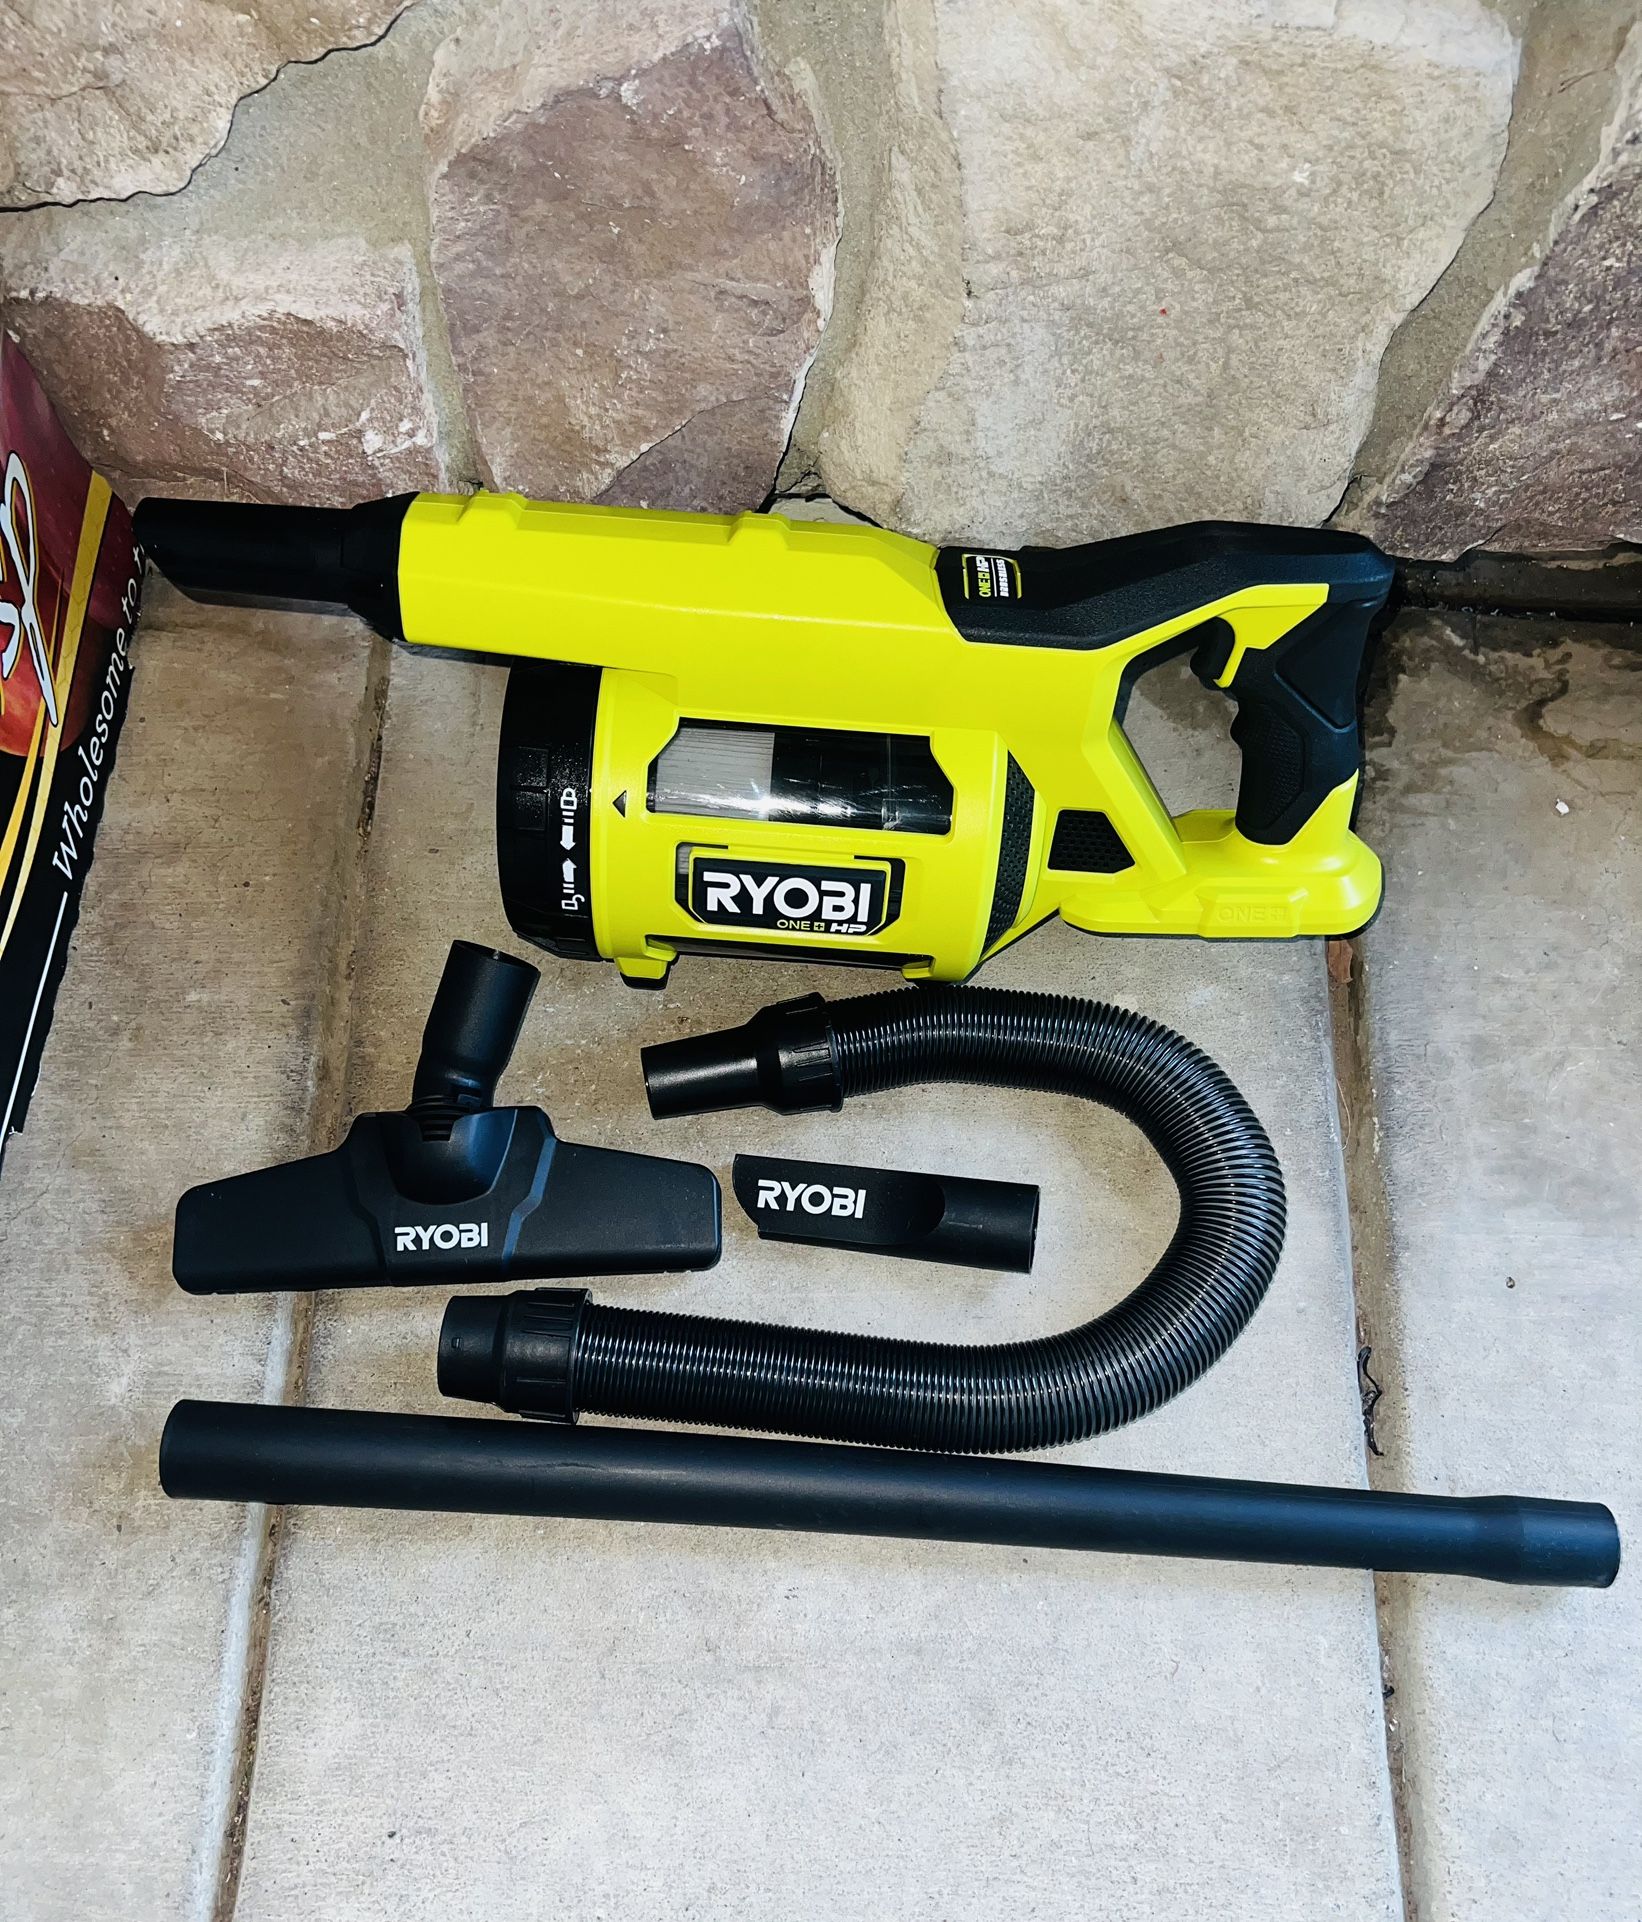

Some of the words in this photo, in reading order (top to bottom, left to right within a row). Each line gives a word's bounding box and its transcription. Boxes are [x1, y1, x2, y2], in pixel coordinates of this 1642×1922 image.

[52, 627, 128, 880] Wholesome
[121, 578, 138, 624] to
[703, 871, 872, 923] RYOBI
[829, 922, 867, 934] HP
[756, 1179, 867, 1219] RYOBI
[394, 1222, 489, 1252] RYOBI
